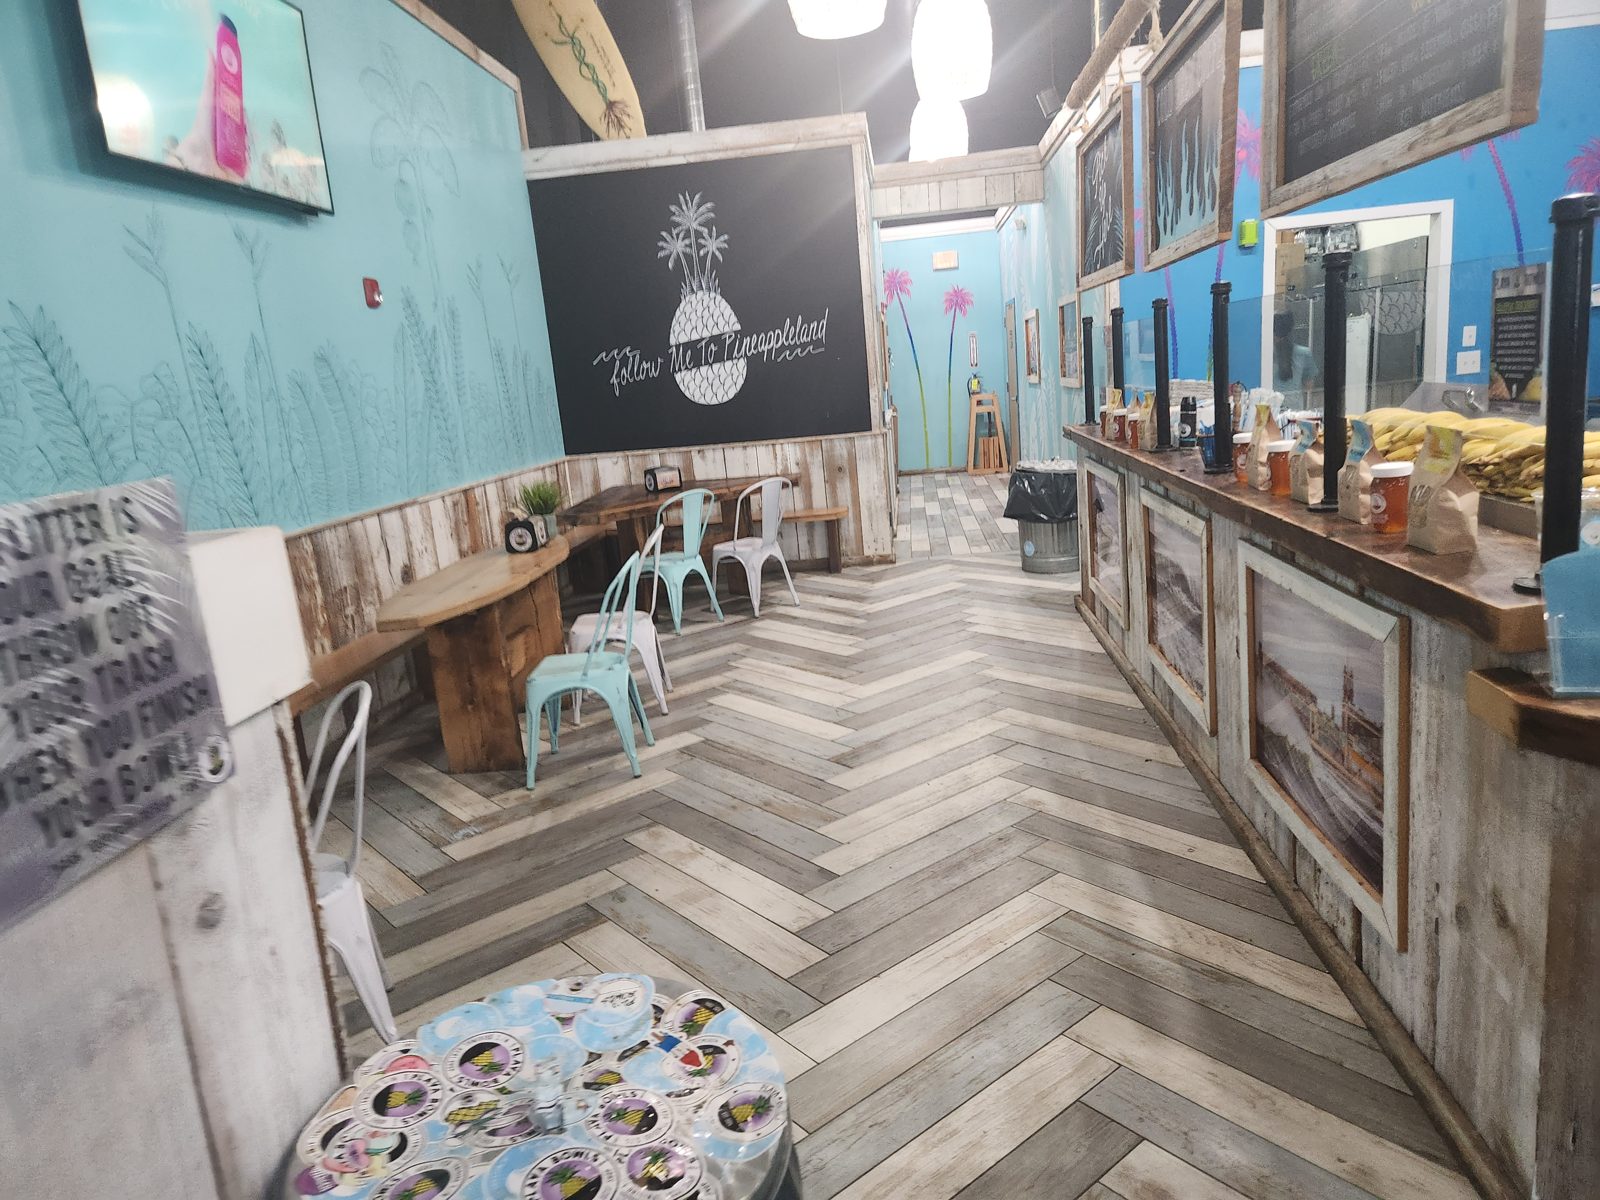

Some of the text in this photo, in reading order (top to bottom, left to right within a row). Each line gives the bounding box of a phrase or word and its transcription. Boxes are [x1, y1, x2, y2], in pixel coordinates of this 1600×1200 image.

[668, 343, 693, 374] Me
[697, 337, 717, 365] To
[722, 307, 829, 362] Pineappleland
